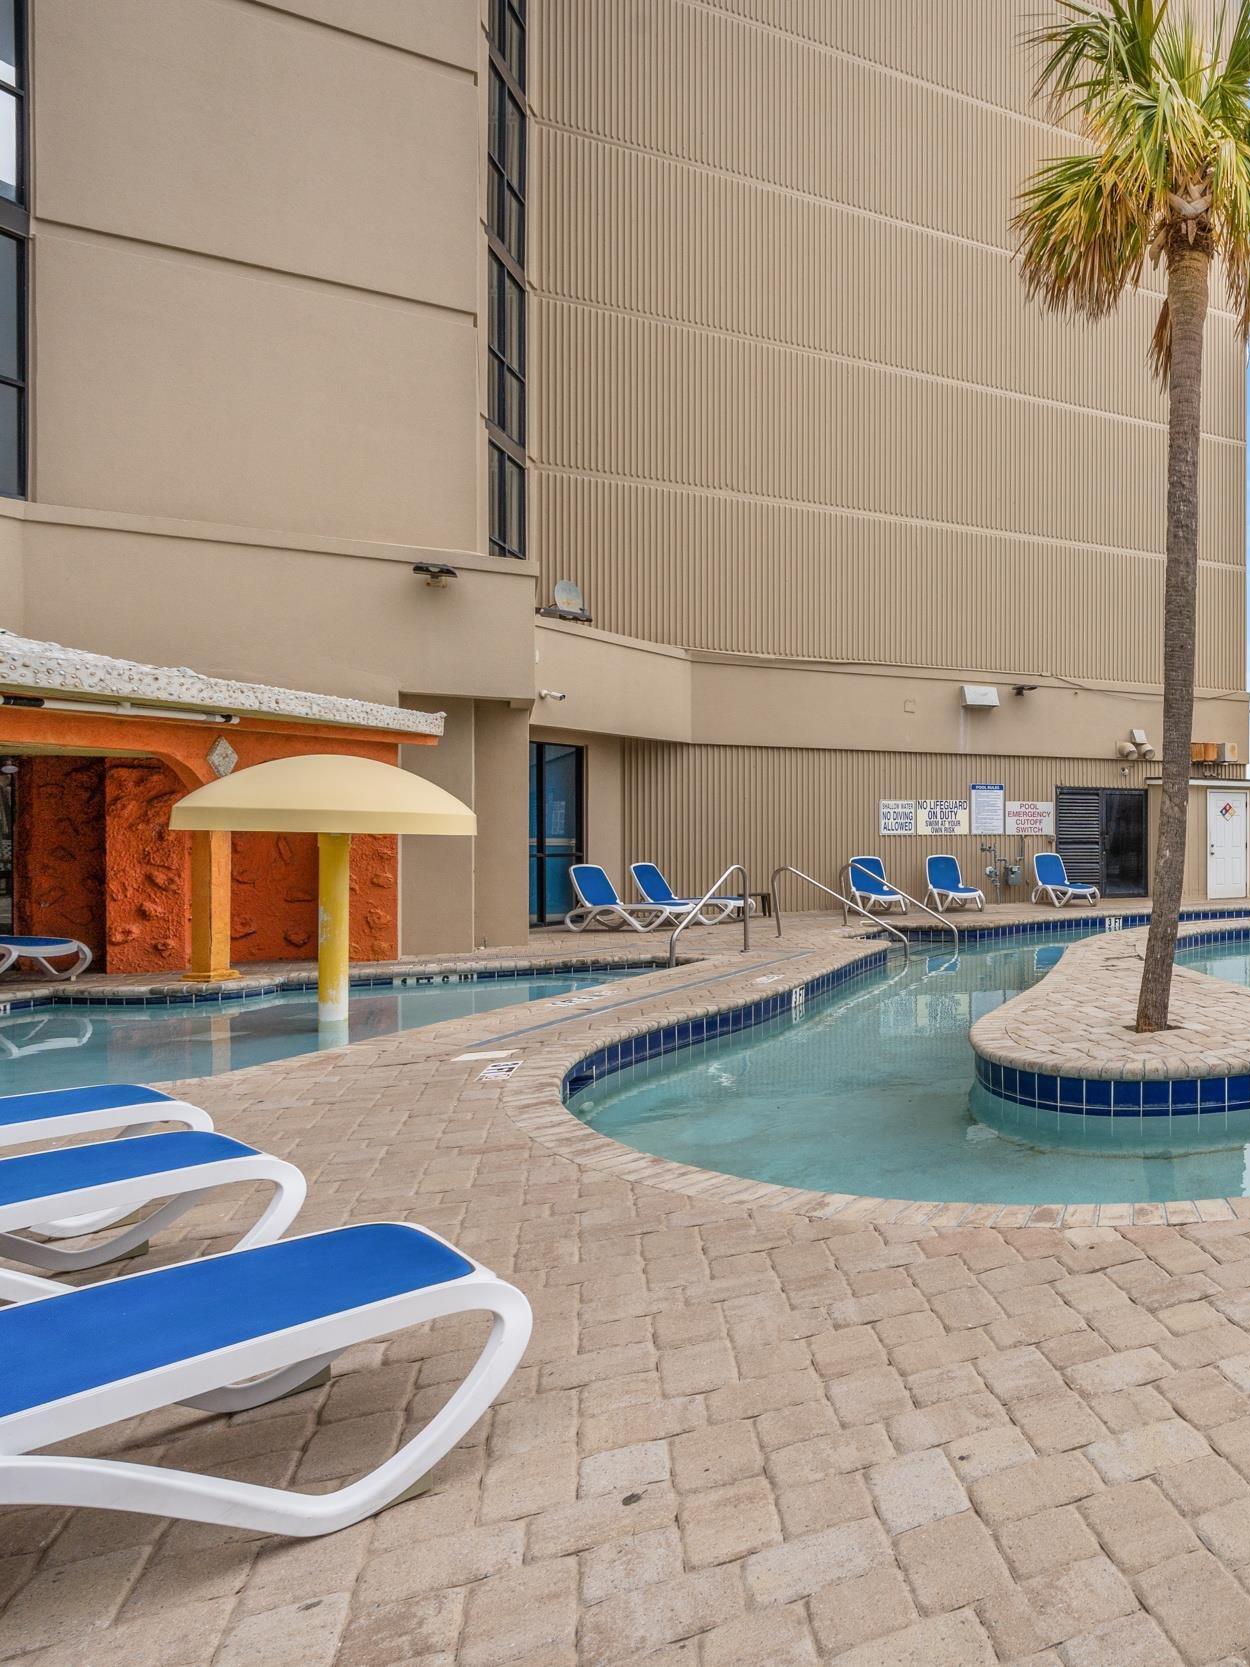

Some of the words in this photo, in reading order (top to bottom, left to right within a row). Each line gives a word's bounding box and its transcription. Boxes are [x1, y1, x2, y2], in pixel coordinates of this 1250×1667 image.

[918, 801, 928, 810] NO
[930, 801, 968, 810] LIFEGUARD
[882, 811, 891, 820] NO
[893, 811, 913, 820] DIVING
[928, 810, 938, 820] ON
[940, 810, 958, 820] DUTY
[883, 822, 912, 831] ALLOWED
